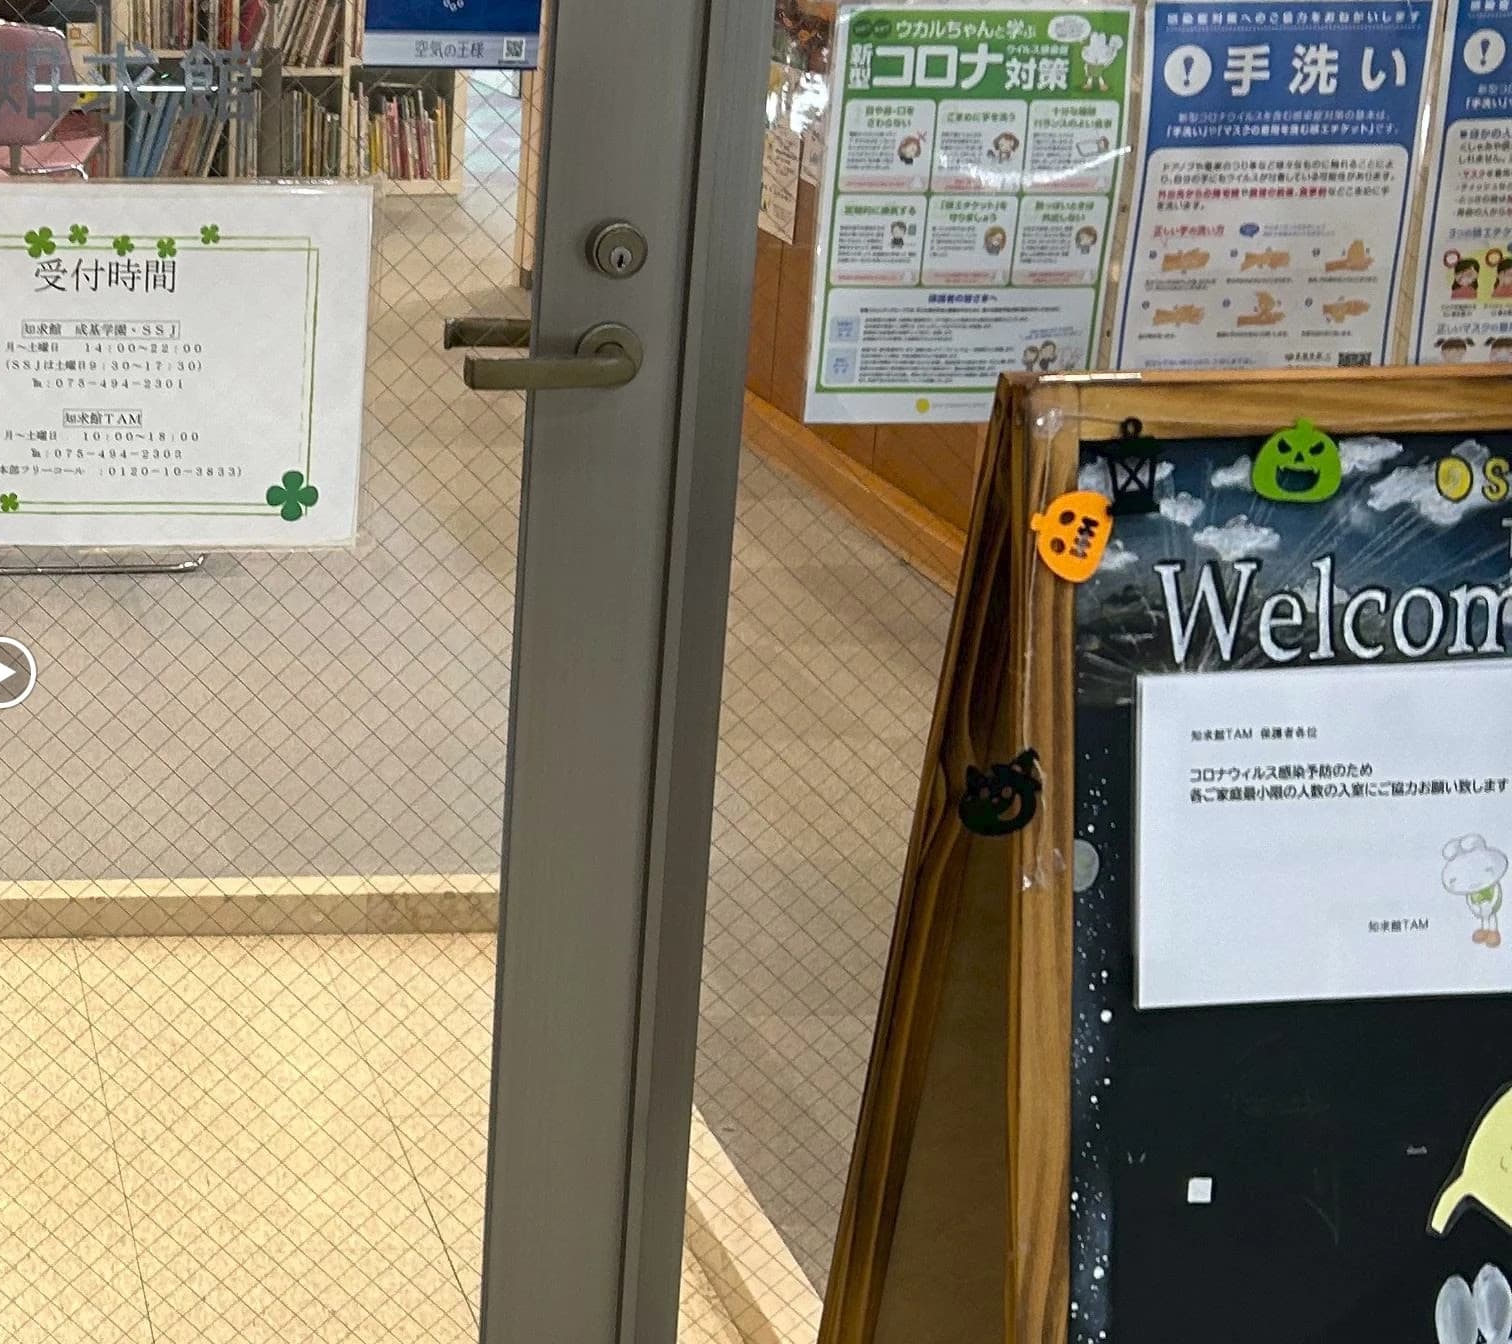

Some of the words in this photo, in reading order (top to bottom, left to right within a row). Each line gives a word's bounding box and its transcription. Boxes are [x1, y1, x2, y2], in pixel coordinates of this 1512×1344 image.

[415, 39, 485, 59] 空気の王様
[872, 43, 1005, 90] コロナ
[1004, 57, 1070, 91] 対策
[1223, 42, 1407, 97] 手洗い
[33, 257, 178, 294] 受付時間
